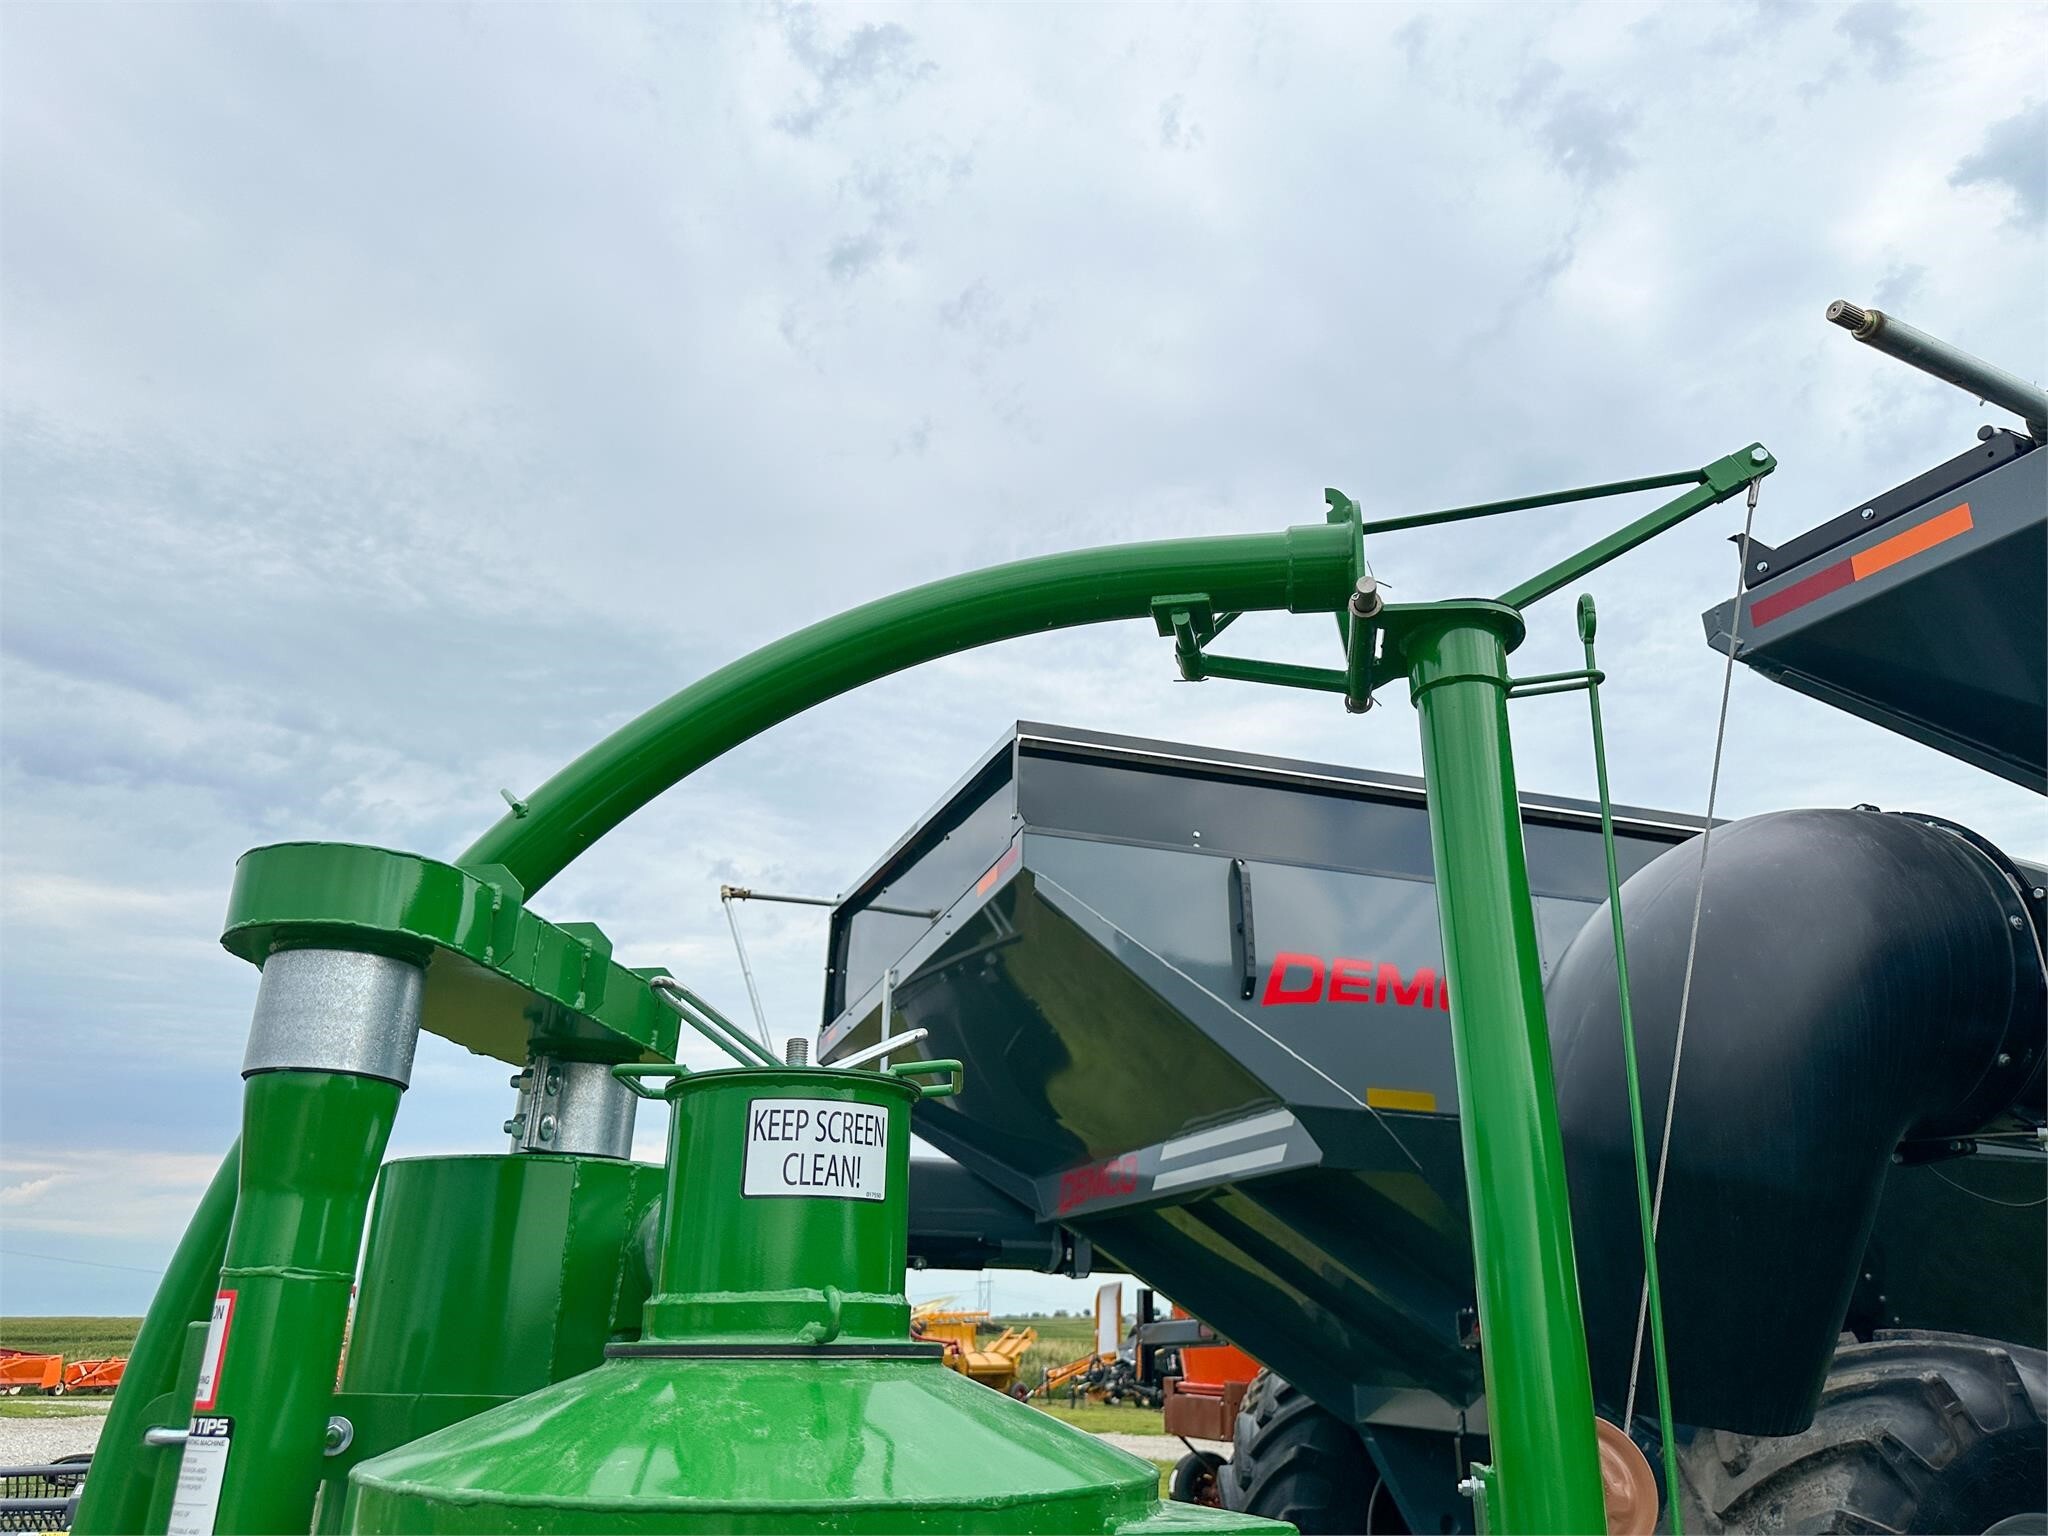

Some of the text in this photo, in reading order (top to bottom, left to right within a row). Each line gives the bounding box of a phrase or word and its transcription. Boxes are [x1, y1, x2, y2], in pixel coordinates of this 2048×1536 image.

[753, 1109, 885, 1148] KEEP SCREEN
[782, 1152, 861, 1189] CLEAN!
[1058, 1154, 1137, 1216] DEMCO
[197, 1417, 229, 1436] TIPS
